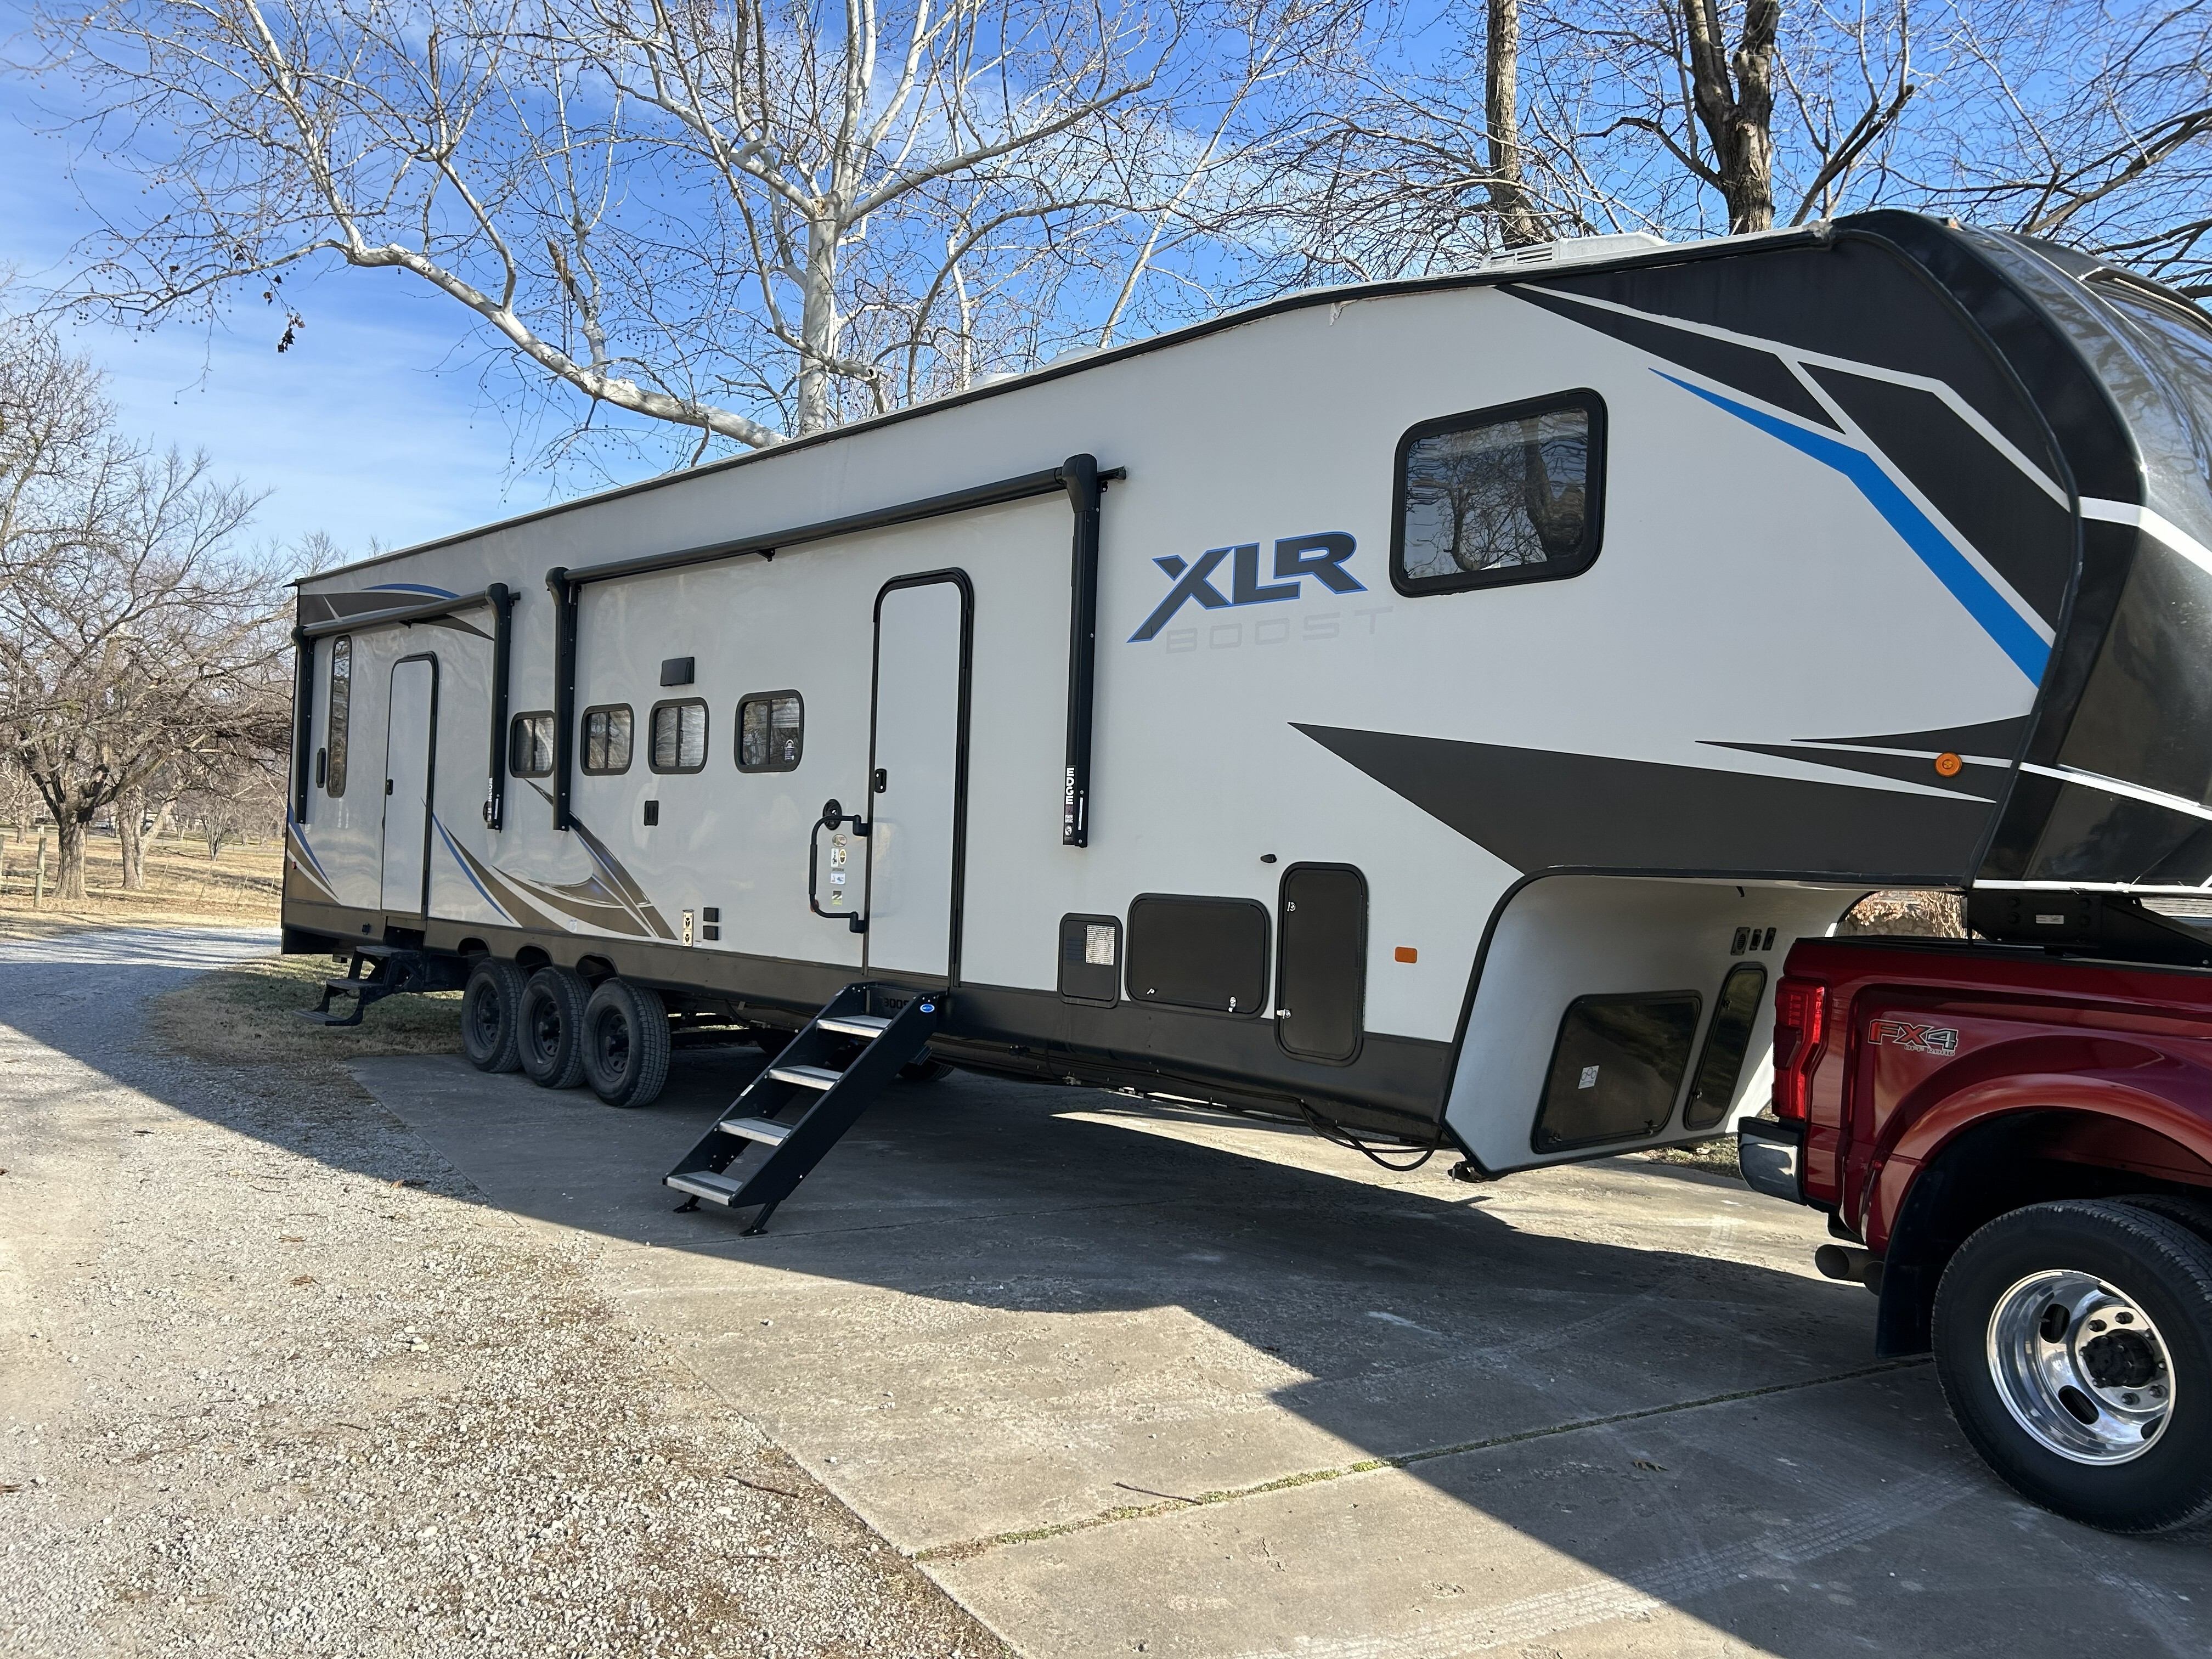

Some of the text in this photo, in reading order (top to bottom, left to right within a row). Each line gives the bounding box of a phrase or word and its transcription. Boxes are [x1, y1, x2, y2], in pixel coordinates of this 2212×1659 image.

[1126, 531, 1369, 644] XLR
[1165, 606, 1394, 654] BOOST
[1065, 768, 1074, 805] EDGE
[1867, 1019, 1959, 1052] FX4
[1927, 1048, 1955, 1057] ROAD
